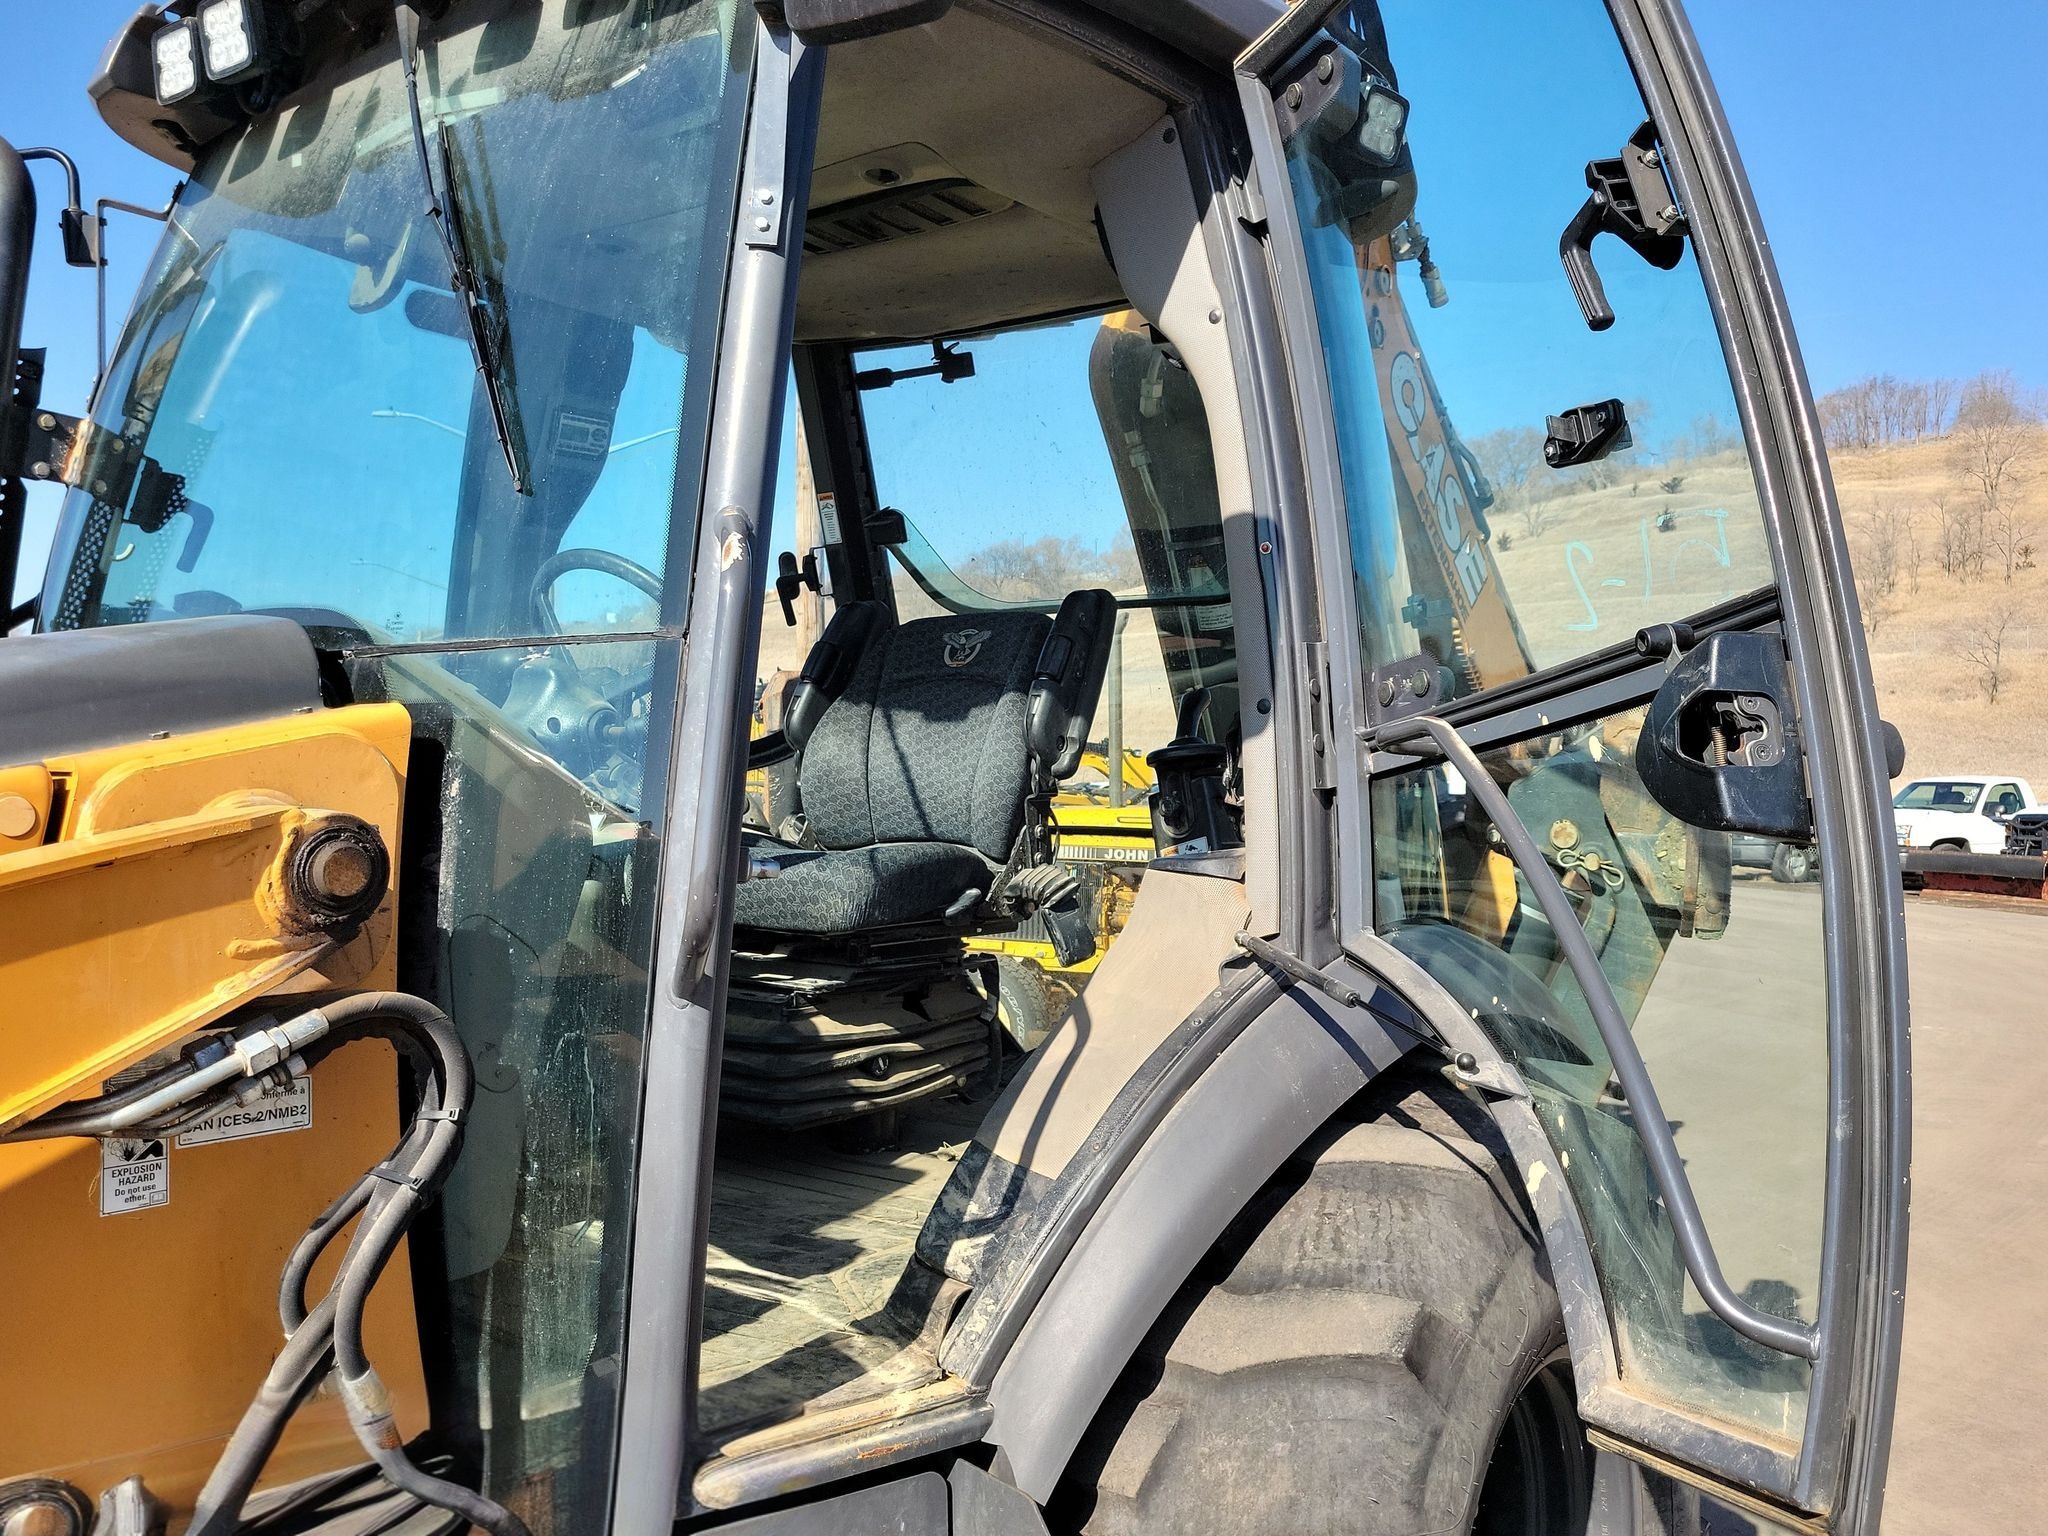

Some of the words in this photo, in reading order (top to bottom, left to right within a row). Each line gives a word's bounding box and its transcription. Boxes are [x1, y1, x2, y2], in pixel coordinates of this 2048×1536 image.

[1390, 350, 1488, 609] CASE
[1104, 849, 1148, 860] JOHN
[183, 1118, 214, 1133] AN
[111, 1162, 162, 1178] EXPLOSION
[118, 1173, 156, 1186] HAZARD
[114, 1188, 126, 1197] Do
[127, 1186, 141, 1195] not
[142, 1183, 157, 1192] use
[124, 1194, 147, 1204] ether.
